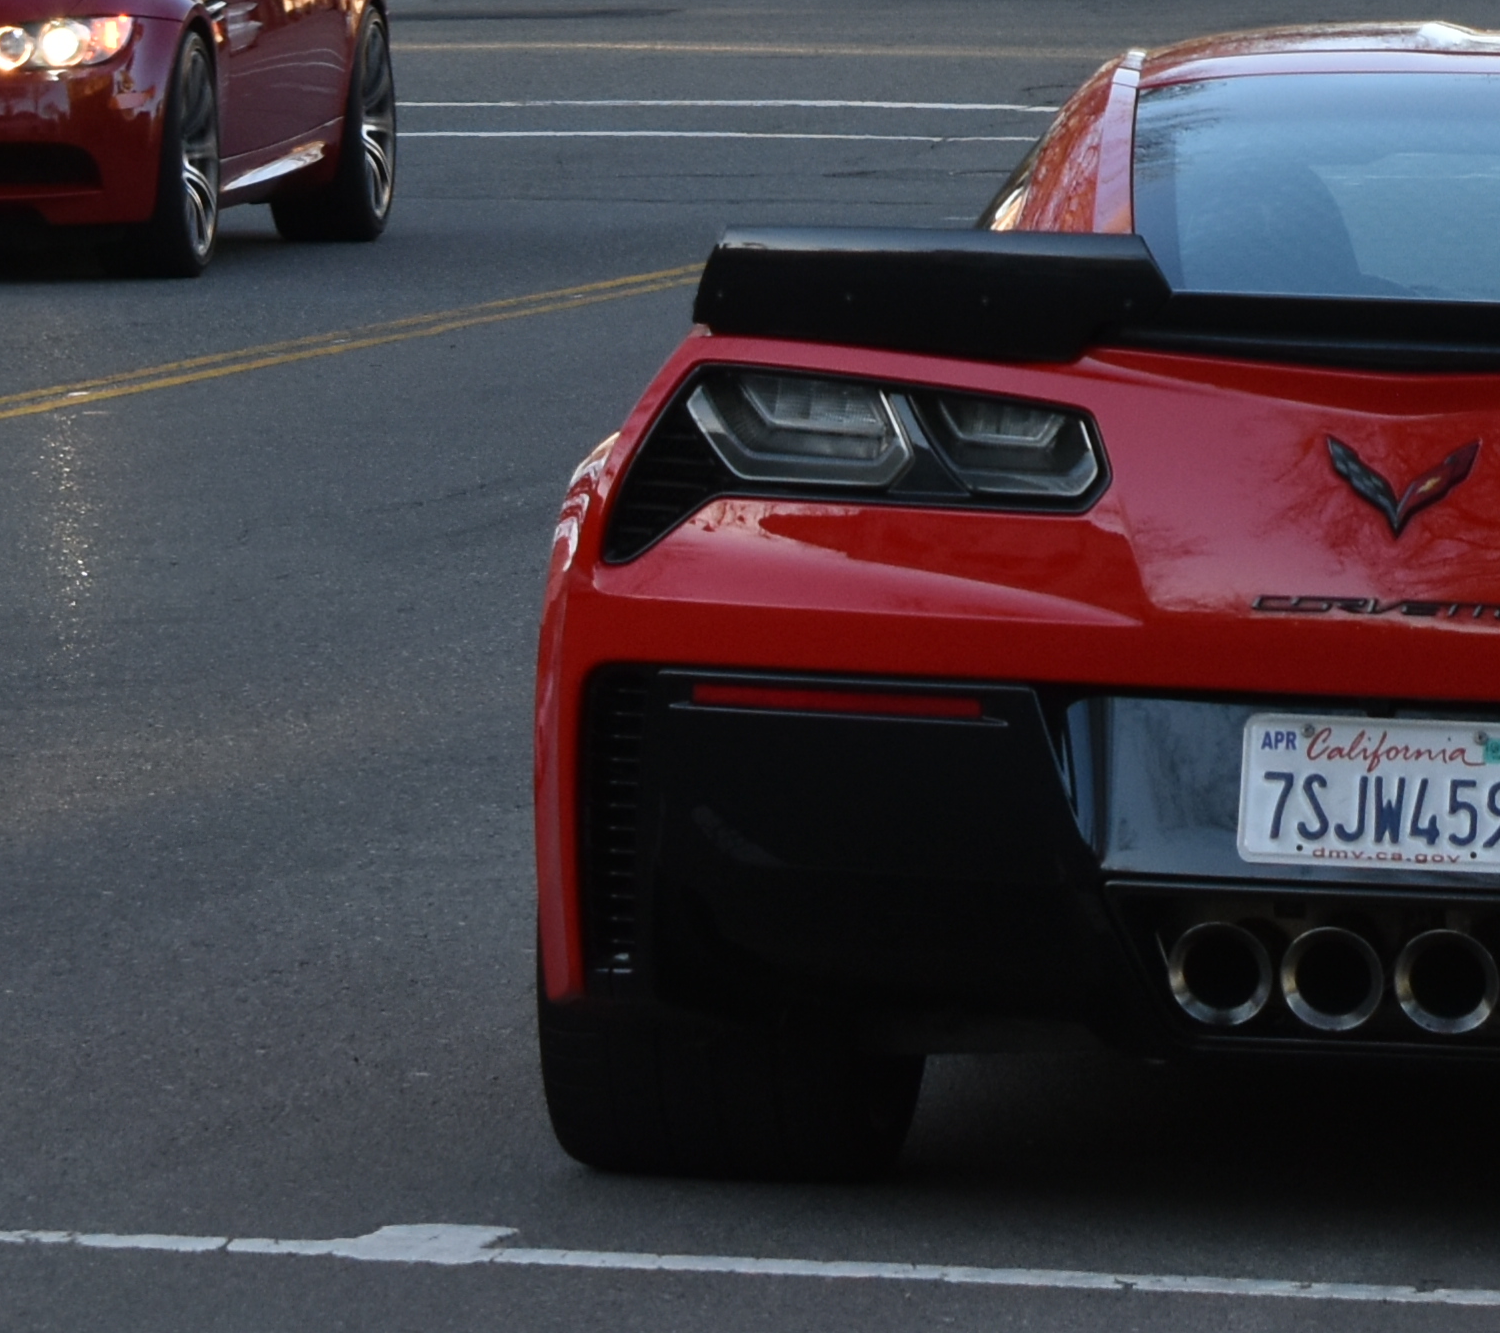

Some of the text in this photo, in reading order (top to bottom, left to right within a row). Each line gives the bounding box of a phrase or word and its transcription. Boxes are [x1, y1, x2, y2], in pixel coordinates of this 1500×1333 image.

[1260, 730, 1298, 751] APR
[1305, 726, 1487, 773] California
[1312, 846, 1461, 865] dmv.ca.gov
